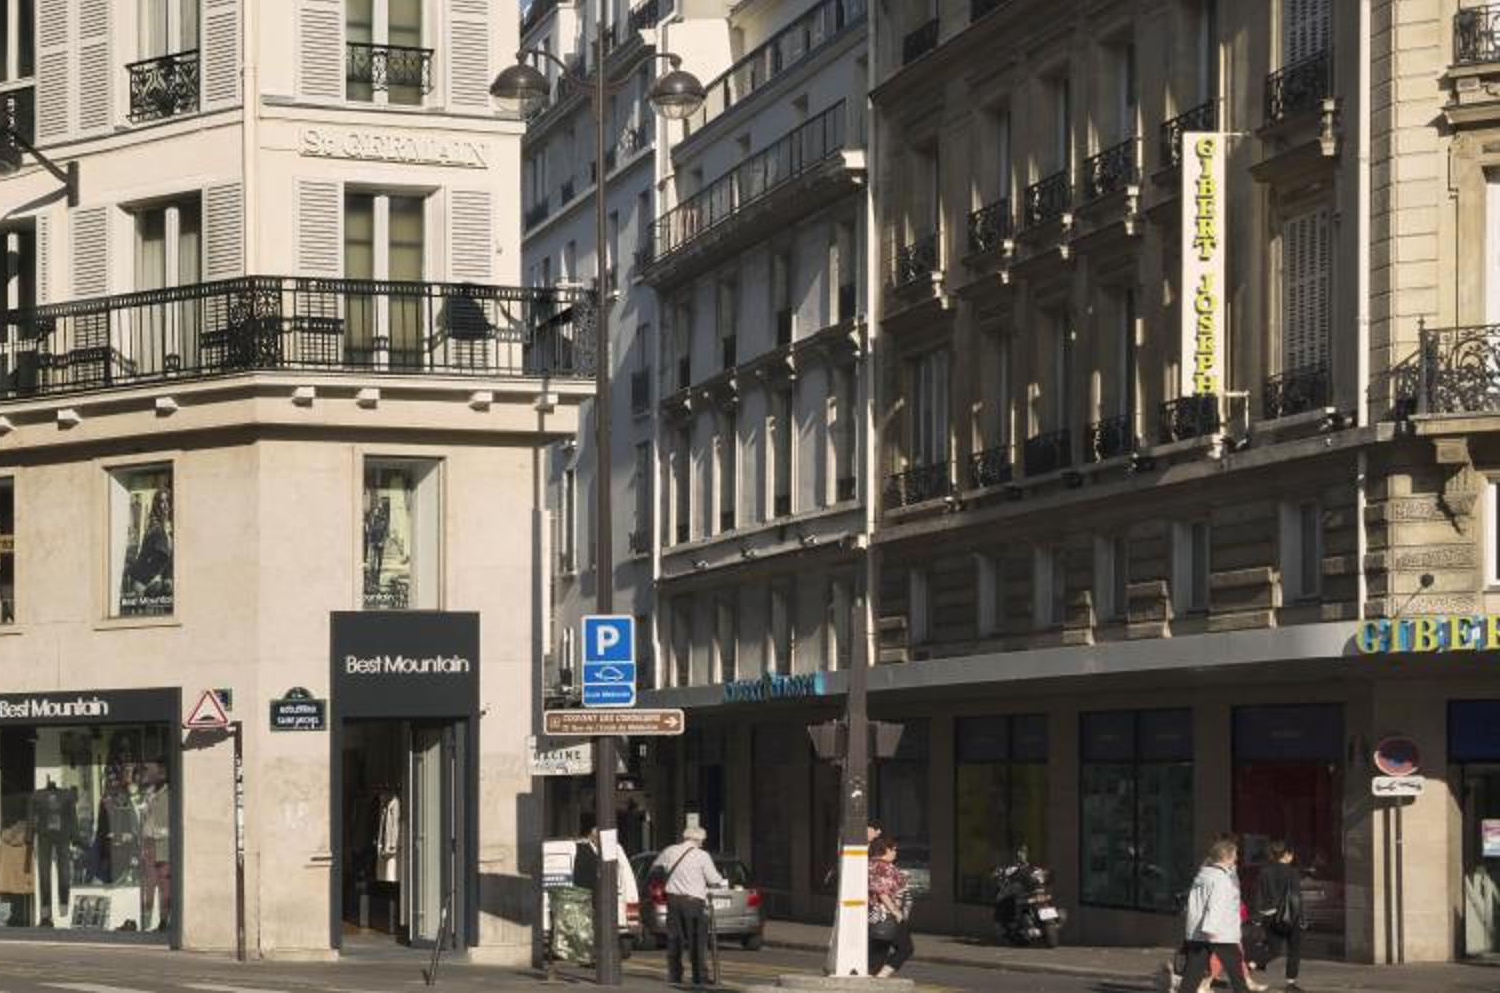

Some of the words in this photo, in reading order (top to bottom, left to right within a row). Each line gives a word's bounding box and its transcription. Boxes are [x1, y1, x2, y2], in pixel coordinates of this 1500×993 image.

[1195, 137, 1218, 261] GIBERT
[1193, 274, 1217, 396] JOSEPH
[596, 625, 619, 656] P
[345, 655, 381, 674] Best
[384, 653, 470, 674] Mountain
[31, 697, 109, 717] Mountain
